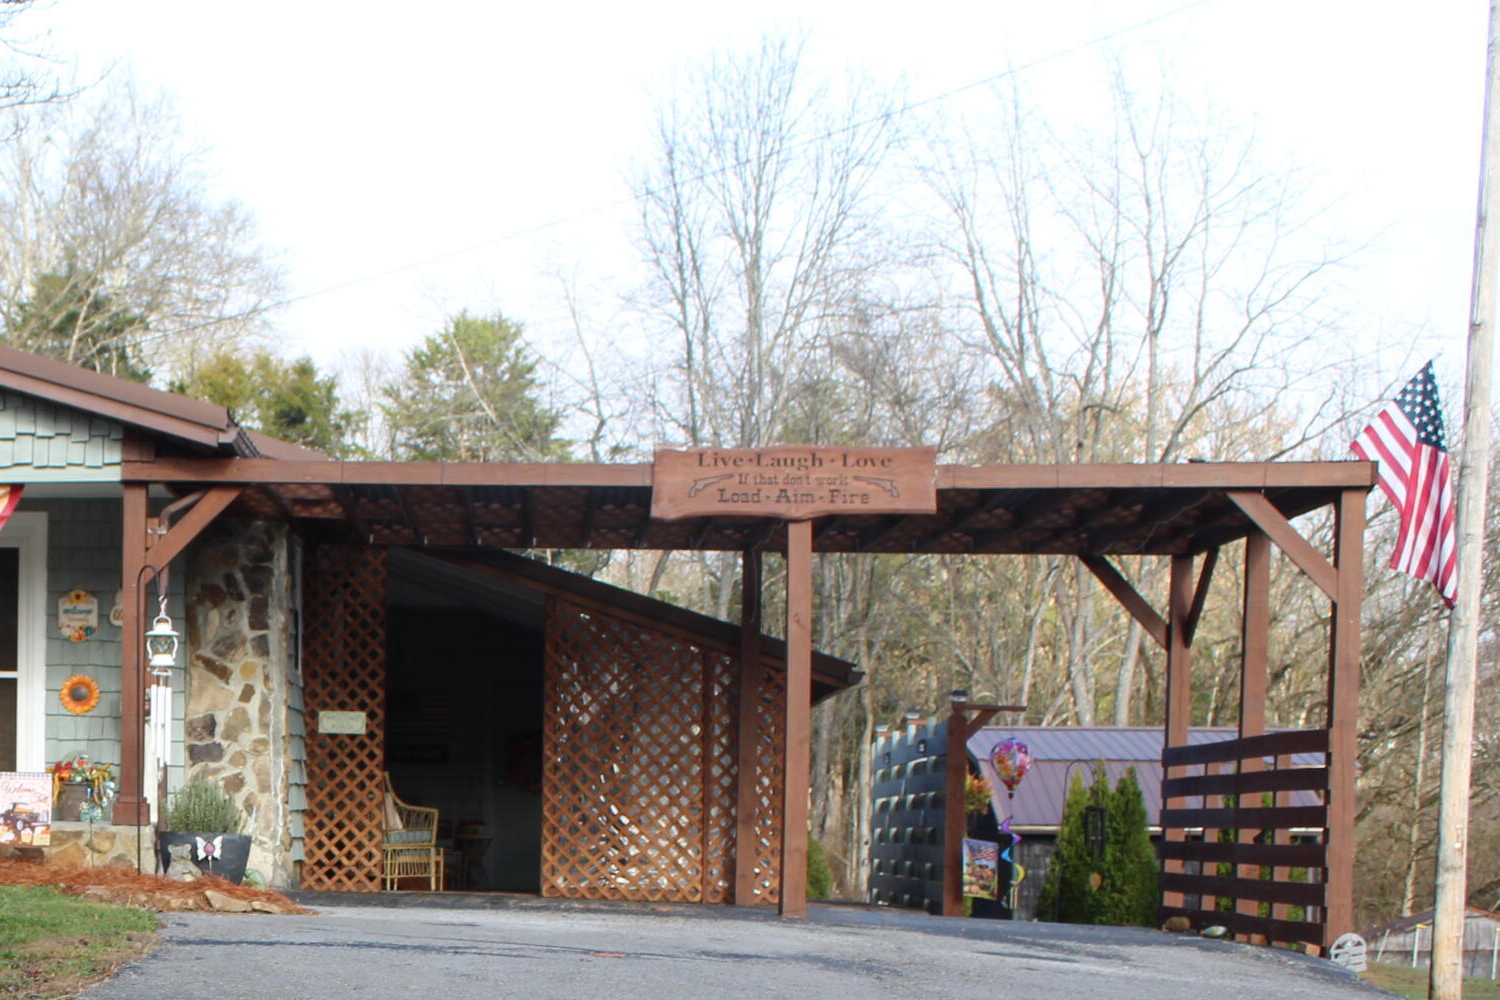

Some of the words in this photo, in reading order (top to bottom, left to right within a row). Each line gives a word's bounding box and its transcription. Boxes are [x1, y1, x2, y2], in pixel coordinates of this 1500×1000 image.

[697, 451, 744, 468] Live
[756, 451, 823, 471] Laugh
[841, 452, 893, 468] Love
[738, 472, 750, 485] If
[754, 473, 779, 485] that
[783, 473, 811, 486] don't
[815, 474, 849, 486] work
[717, 487, 762, 504] Load
[775, 487, 815, 504] Aim
[828, 487, 871, 505] Fire
